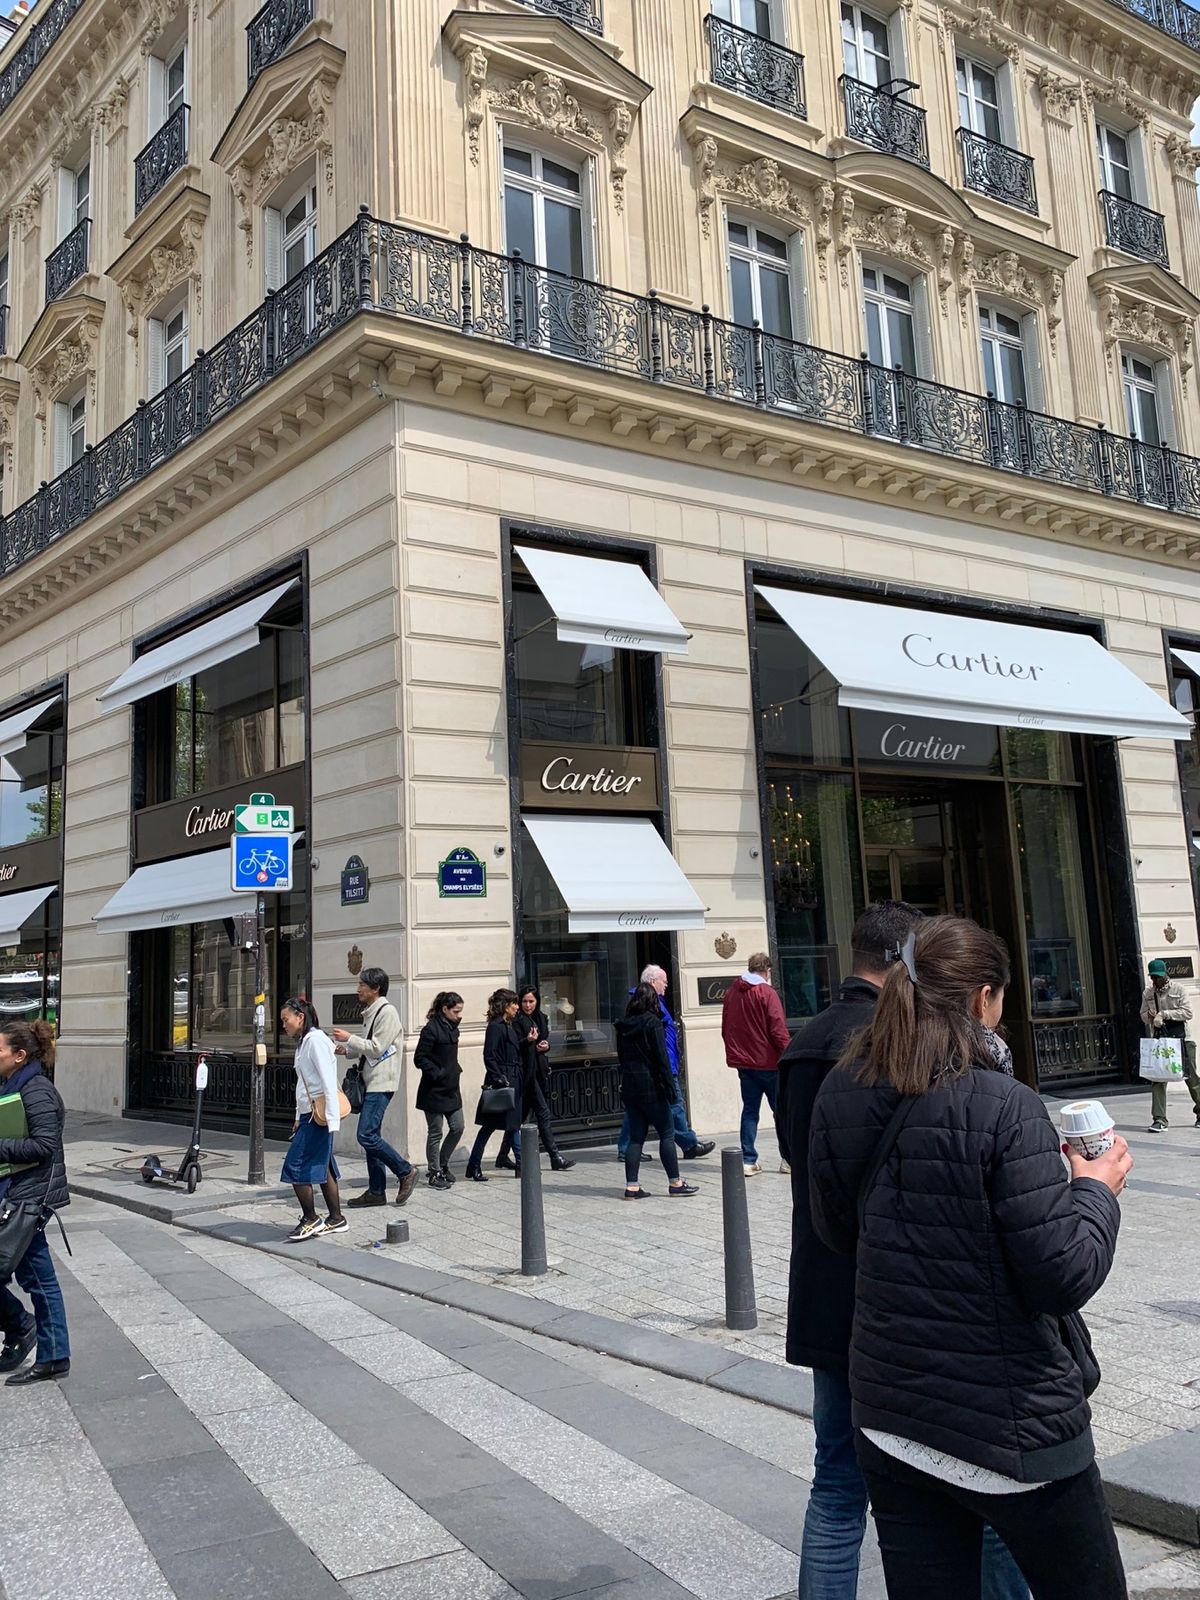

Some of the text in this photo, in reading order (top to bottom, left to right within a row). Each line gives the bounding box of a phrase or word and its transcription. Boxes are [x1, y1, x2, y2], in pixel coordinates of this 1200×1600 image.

[604, 628, 643, 644] Cartier
[902, 633, 1044, 681] Cartier
[163, 670, 183, 684] Cartier
[1018, 712, 1044, 726] Cartier
[880, 723, 966, 761] Cartier
[541, 756, 642, 793] Cartier
[259, 796, 266, 804] 4
[185, 805, 235, 837] Cartier
[260, 815, 266, 823] 5
[0, 863, 17, 881] tier
[349, 875, 359, 886] RUE
[345, 887, 364, 898] TILSITT
[160, 911, 181, 923] Cartier
[617, 911, 659, 927] Cartier
[1167, 963, 1190, 975] artier
